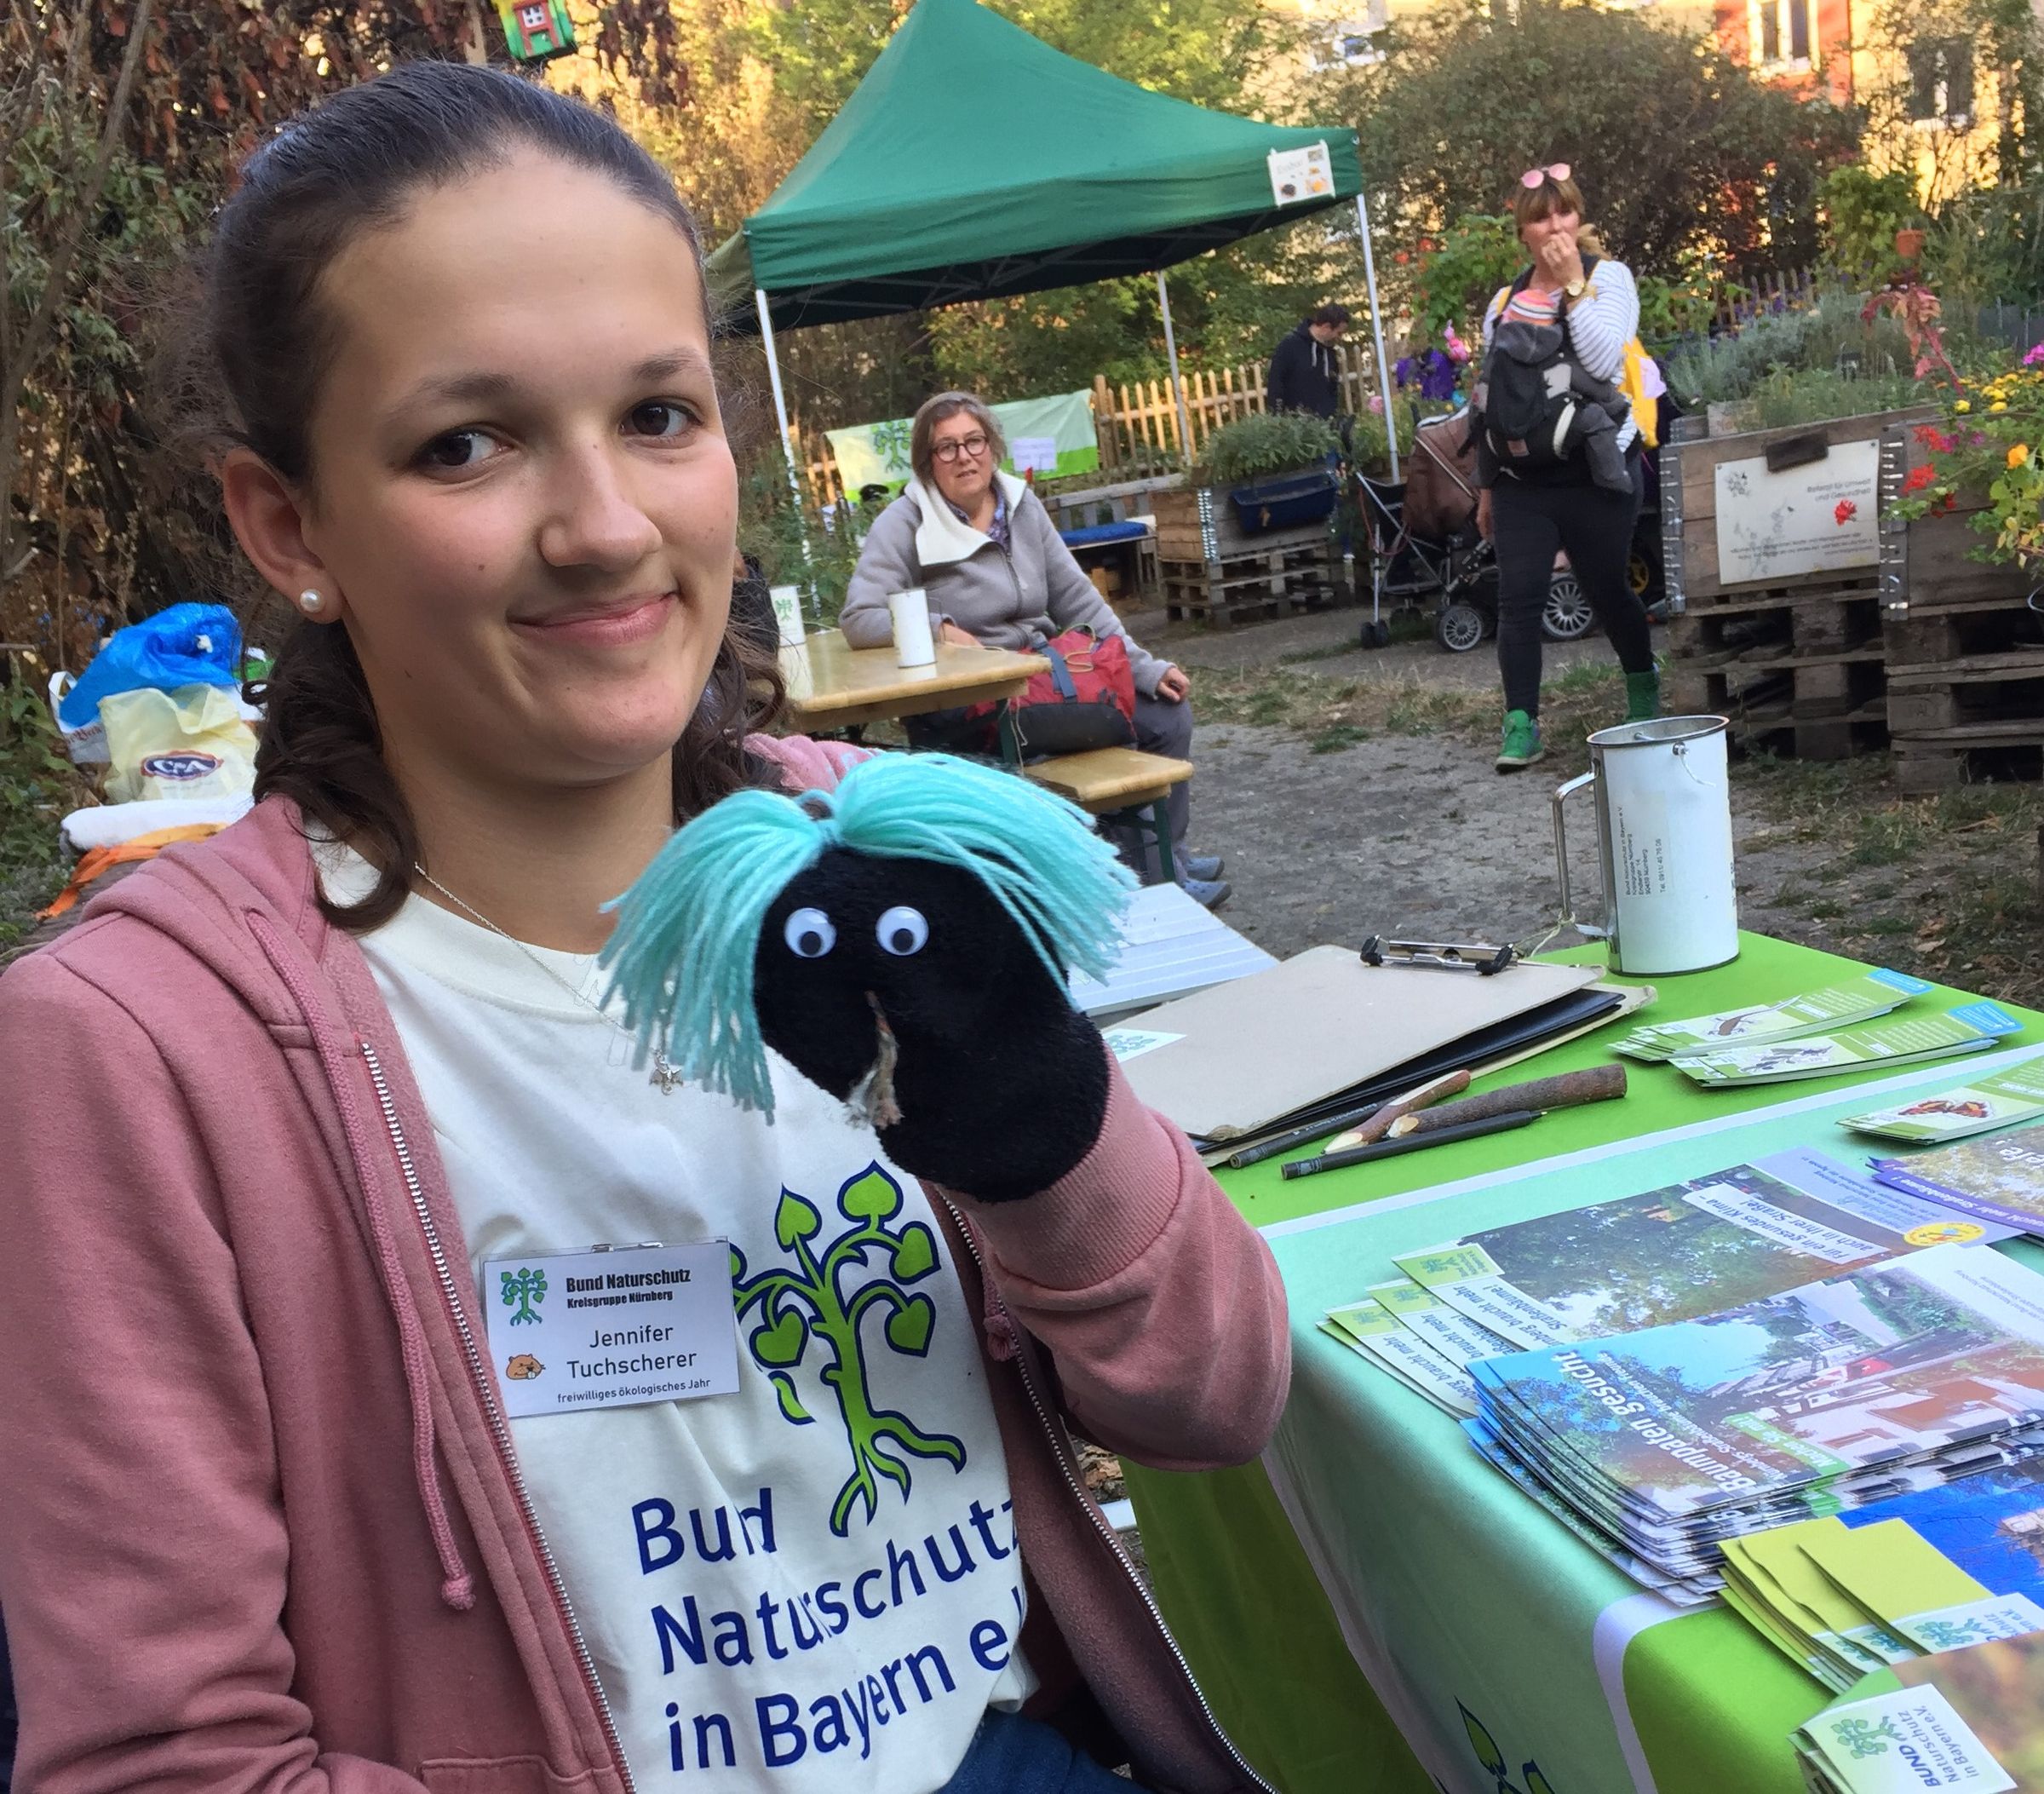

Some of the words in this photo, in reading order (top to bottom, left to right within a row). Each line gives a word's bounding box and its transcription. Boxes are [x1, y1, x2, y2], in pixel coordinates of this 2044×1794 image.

[1706, 1198, 1744, 1218] Klima
[1742, 1216, 1807, 1242] gesundes
[1824, 1250, 1850, 1260] Für
[1836, 1238, 1873, 1251] auch
[566, 1274, 604, 1293] Bund
[606, 1268, 692, 1290] Naturschutz
[567, 1293, 629, 1308] Kreisgruppe
[629, 1290, 674, 1303] Nürnberg
[1453, 1285, 1485, 1303] mehr
[1421, 1314, 1450, 1332] mehr
[1479, 1302, 1523, 1327] braucht
[589, 1325, 674, 1348] Jennifer
[1383, 1336, 1415, 1354] mehr
[1443, 1331, 1484, 1360] braucht
[566, 1352, 698, 1379] Tuchscherer
[1406, 1354, 1452, 1383] braucht
[558, 1389, 617, 1404] freiwilliges
[619, 1381, 686, 1398] ökologisches
[687, 1378, 711, 1390] Jahr
[1550, 1351, 1645, 1416] gesucht
[1762, 1430, 1788, 1444] Sie
[1630, 1417, 1757, 1492] Baumpaten
[631, 1487, 778, 1575] Bud
[652, 1498, 1019, 1675] Natuschut
[665, 1701, 736, 1772] in
[755, 1644, 956, 1768] Bayern
[1898, 1710, 1961, 1783] Naturschutz
[1931, 1724, 1969, 1765] Bayern
[1898, 1744, 1943, 1787] BUND
[1964, 1766, 1980, 1778] in
